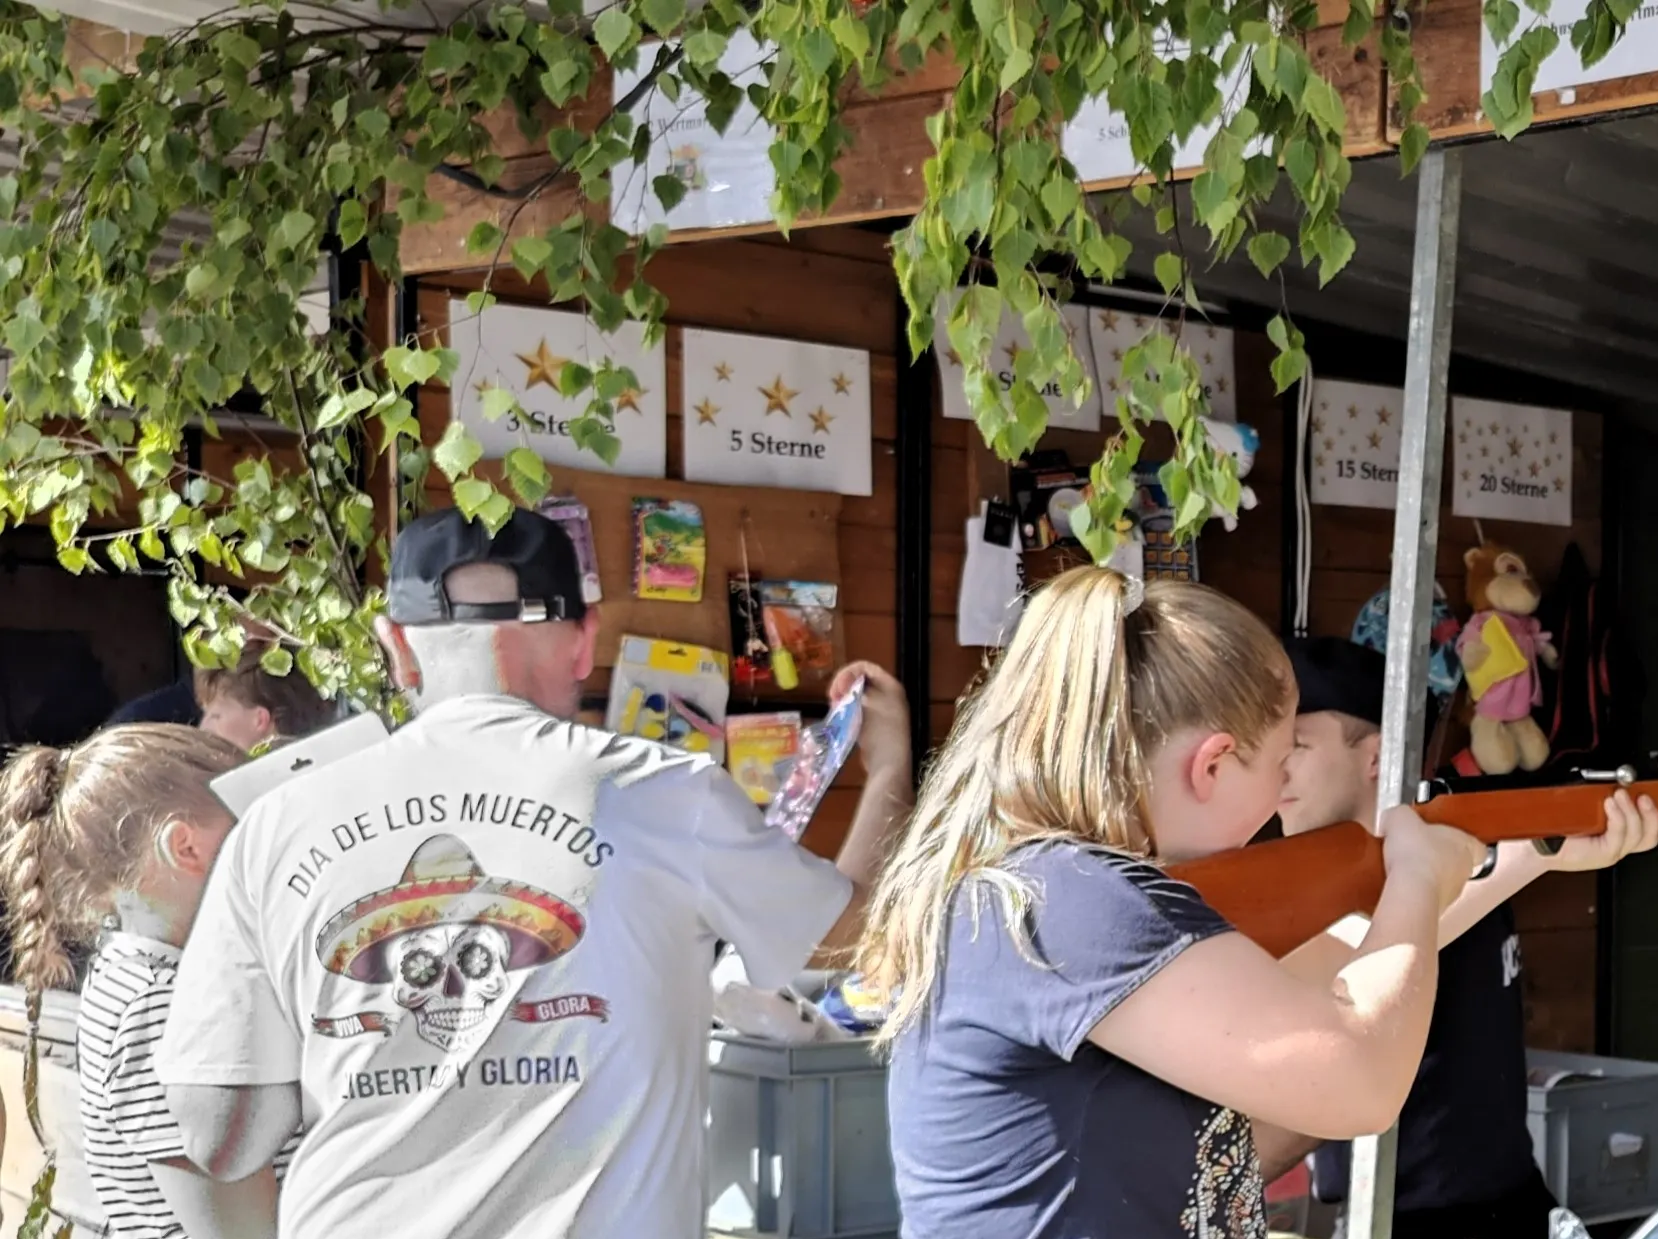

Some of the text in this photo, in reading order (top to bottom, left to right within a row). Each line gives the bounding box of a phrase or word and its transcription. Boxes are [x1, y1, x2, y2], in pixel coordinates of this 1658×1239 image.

[1108, 124, 1128, 139] Sch
[506, 409, 616, 437] 3 Stee
[730, 430, 826, 460] 5 Sterne
[1336, 459, 1356, 479] 15
[1479, 473, 1549, 499] 20 Sterne
[287, 793, 614, 899] DIA DE LOS MUERTOS
[335, 995, 591, 1037] VIVA GLORA
[456, 1061, 471, 1089] Y
[481, 1055, 580, 1086] GLORIA
